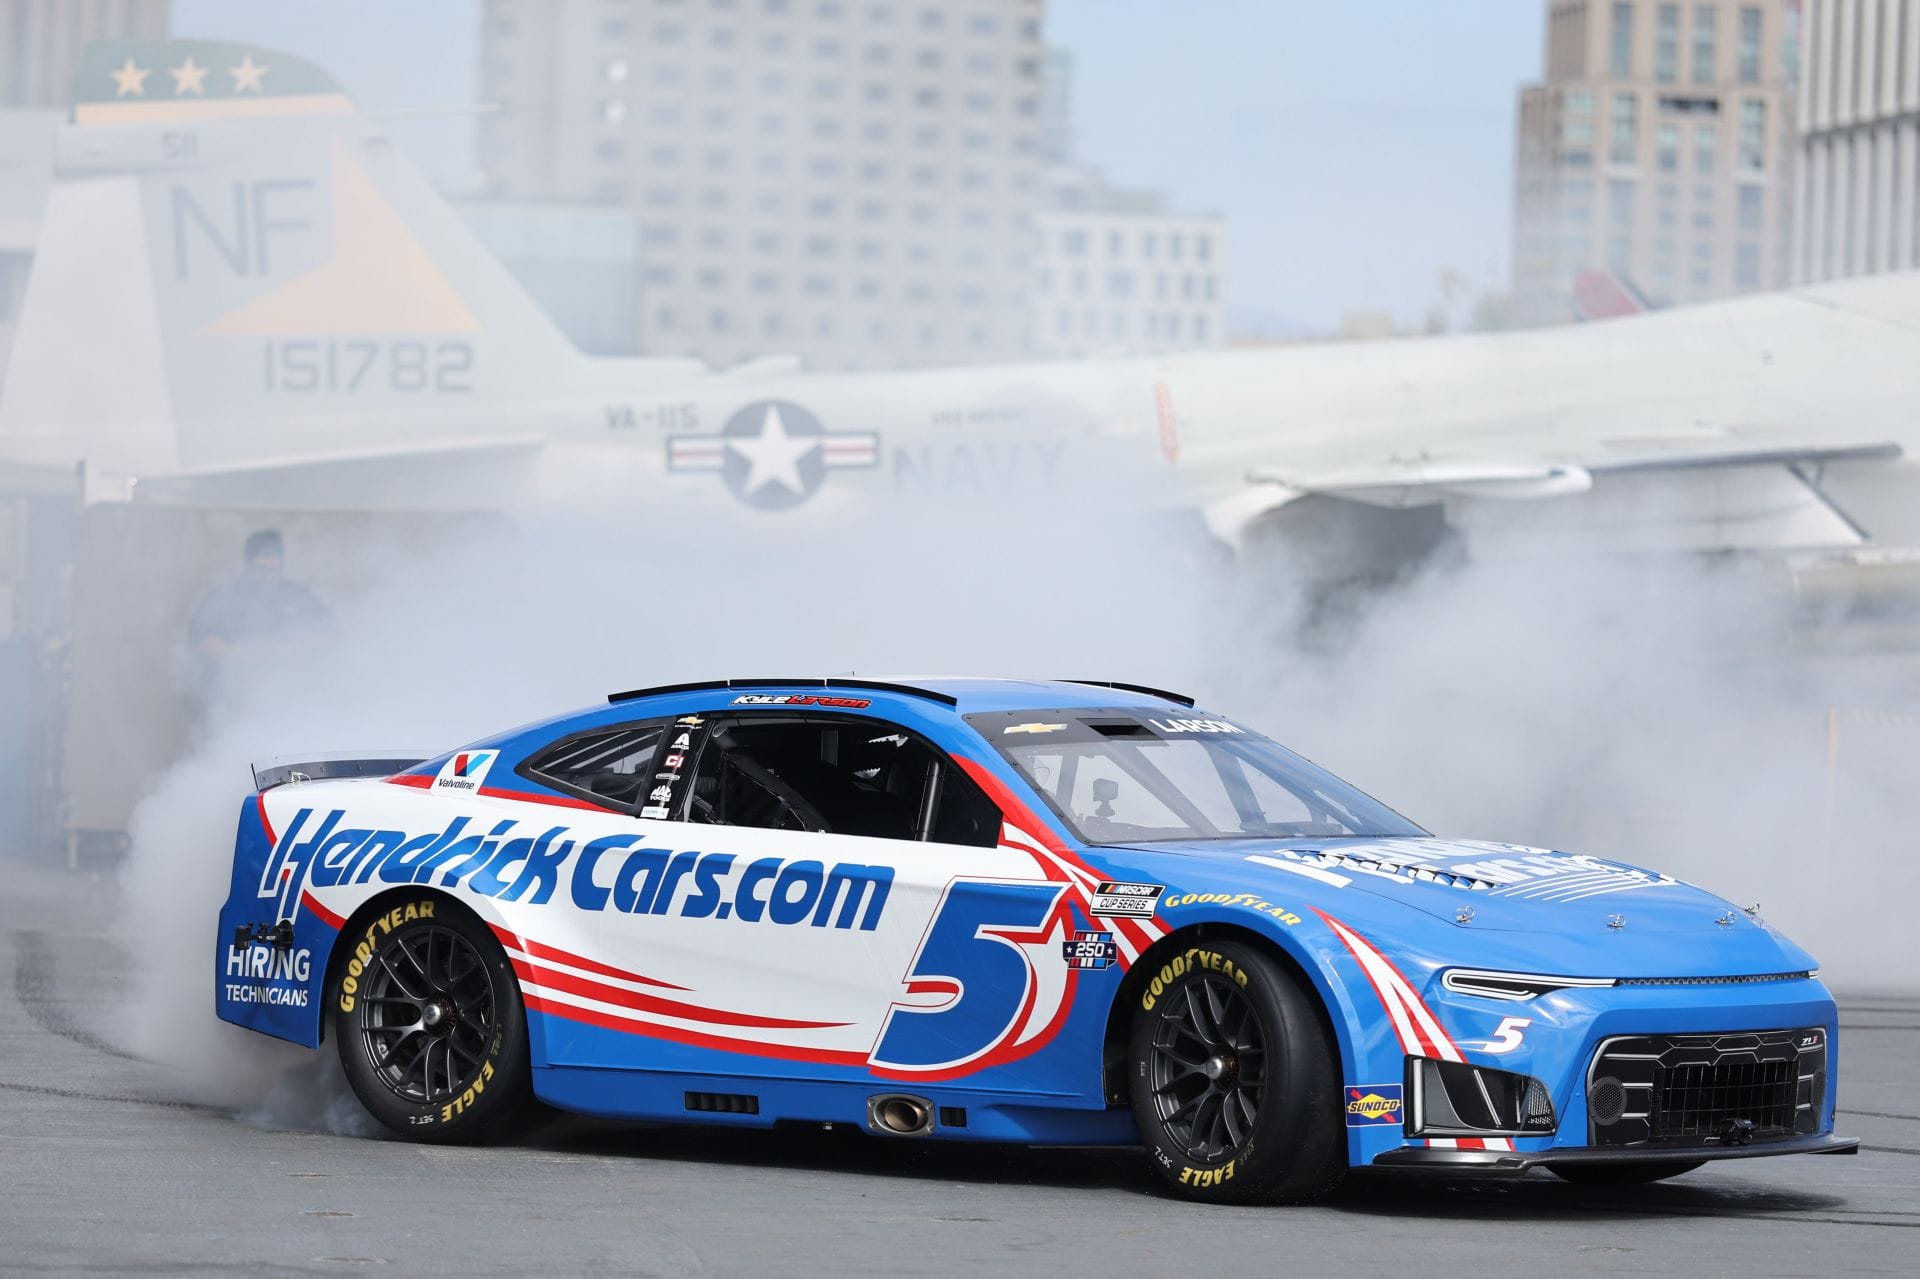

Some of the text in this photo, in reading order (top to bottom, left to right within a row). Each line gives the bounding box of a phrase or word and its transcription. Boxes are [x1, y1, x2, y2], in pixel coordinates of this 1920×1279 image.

[170, 178, 316, 281] NF
[263, 340, 474, 394] 151782
[604, 403, 699, 431] VA-115
[890, 437, 1067, 493] NAVY
[1148, 719, 1246, 734] LARSON
[439, 779, 475, 790] Valvoline
[1099, 898, 1148, 910] CUP SERIES
[1115, 885, 1155, 896] NASCAR
[1165, 892, 1302, 926] GOODYEAR
[226, 944, 311, 982] HIRING
[340, 900, 435, 1013] GOODYEAR
[1075, 942, 1105, 957] 250
[868, 877, 1073, 1072] 5
[1142, 948, 1249, 1011] GOODYEAR
[225, 984, 308, 1007] TECHNICIANS
[1479, 1016, 1531, 1053] 5
[441, 1060, 494, 1123] EAGLE
[1349, 1101, 1398, 1113] SUNOCO
[1179, 1160, 1236, 1188] EAGLE
